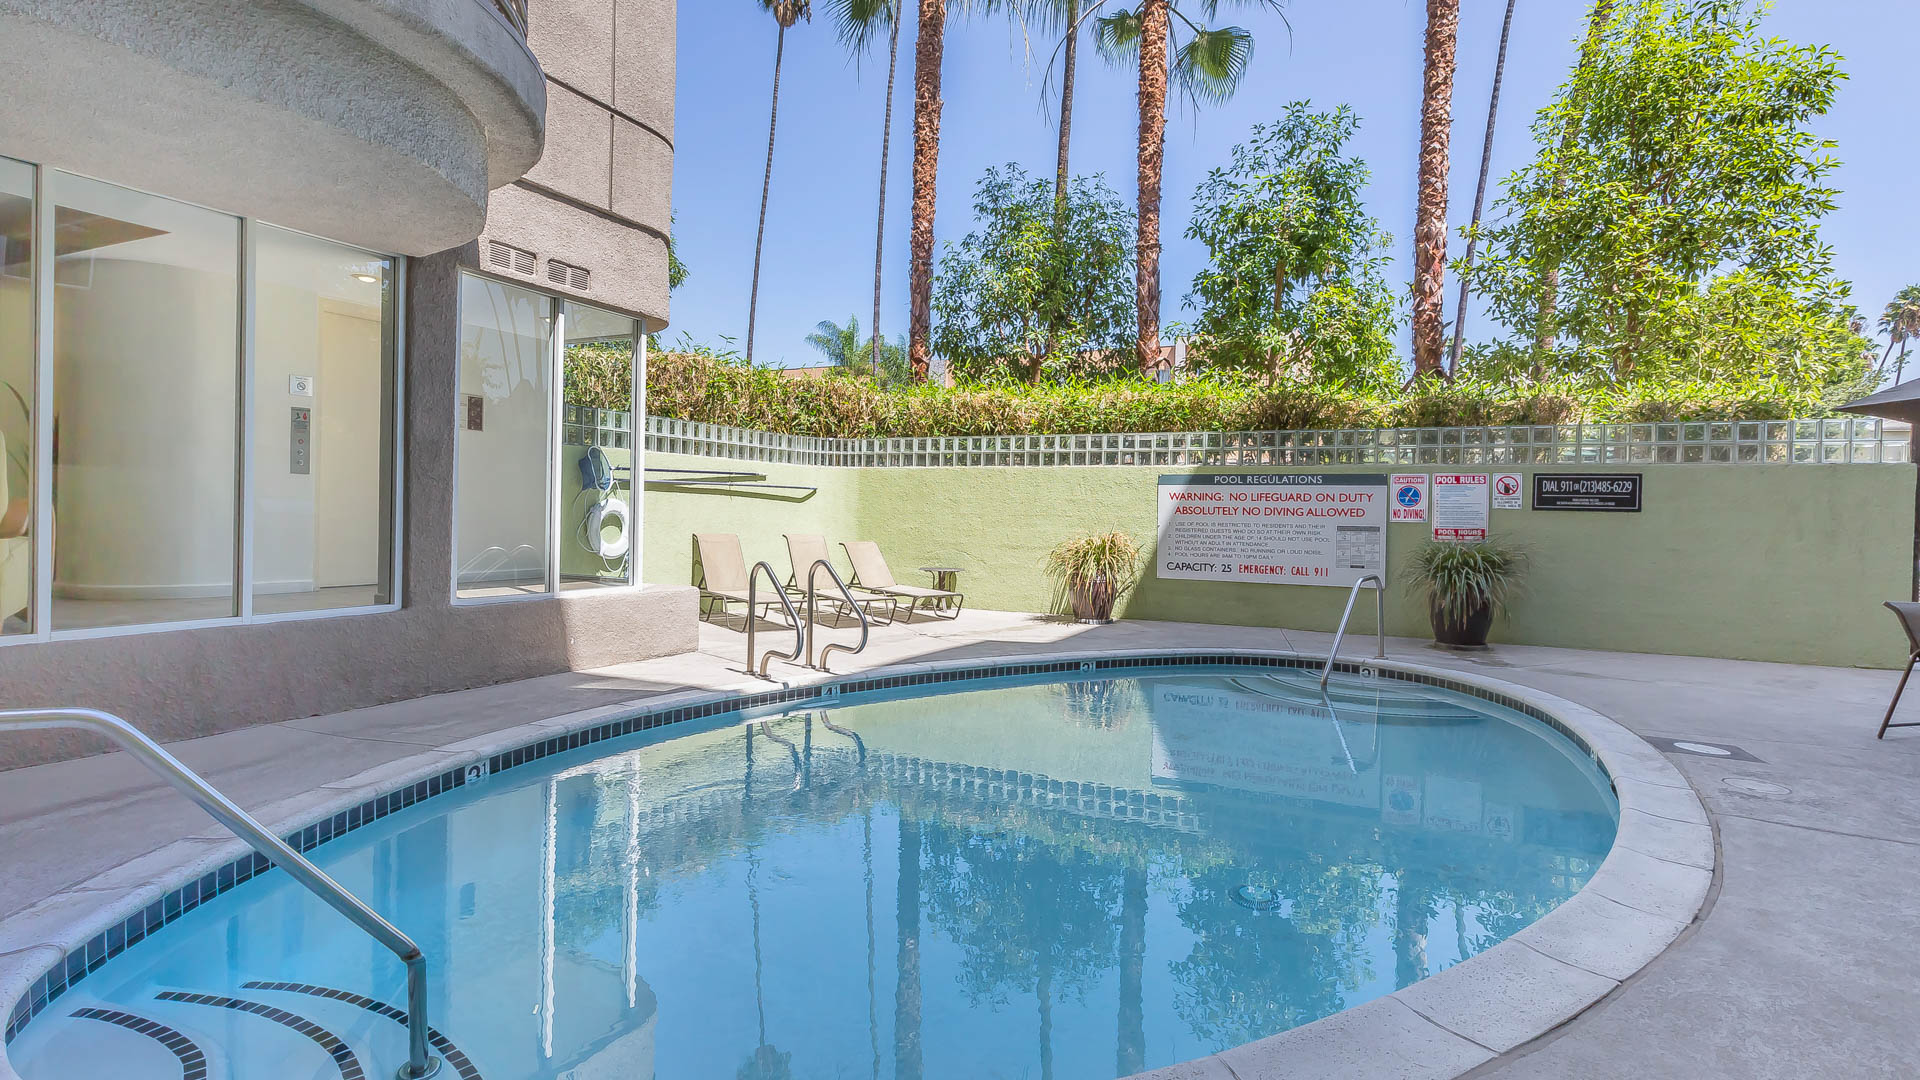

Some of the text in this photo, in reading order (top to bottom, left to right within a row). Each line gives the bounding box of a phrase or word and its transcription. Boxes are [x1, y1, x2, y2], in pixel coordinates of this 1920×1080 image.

[1214, 475, 1323, 484] POOL REGULATIONS
[1437, 476, 1485, 484] POOL RULES
[1542, 480, 1559, 492] DIAL
[1561, 481, 1573, 492] 911
[1580, 480, 1633, 494] (213)485-6229
[1169, 492, 1374, 503] WARNING: NO LIFEGUARD ON DUTY
[1175, 506, 1366, 518] ABSOLUTELY NO DIVING ALLOWED
[1393, 509, 1425, 519] NO DIVING!
[1167, 562, 1328, 577] CAPACITY: 25 EMERGENCY: CALL 911
